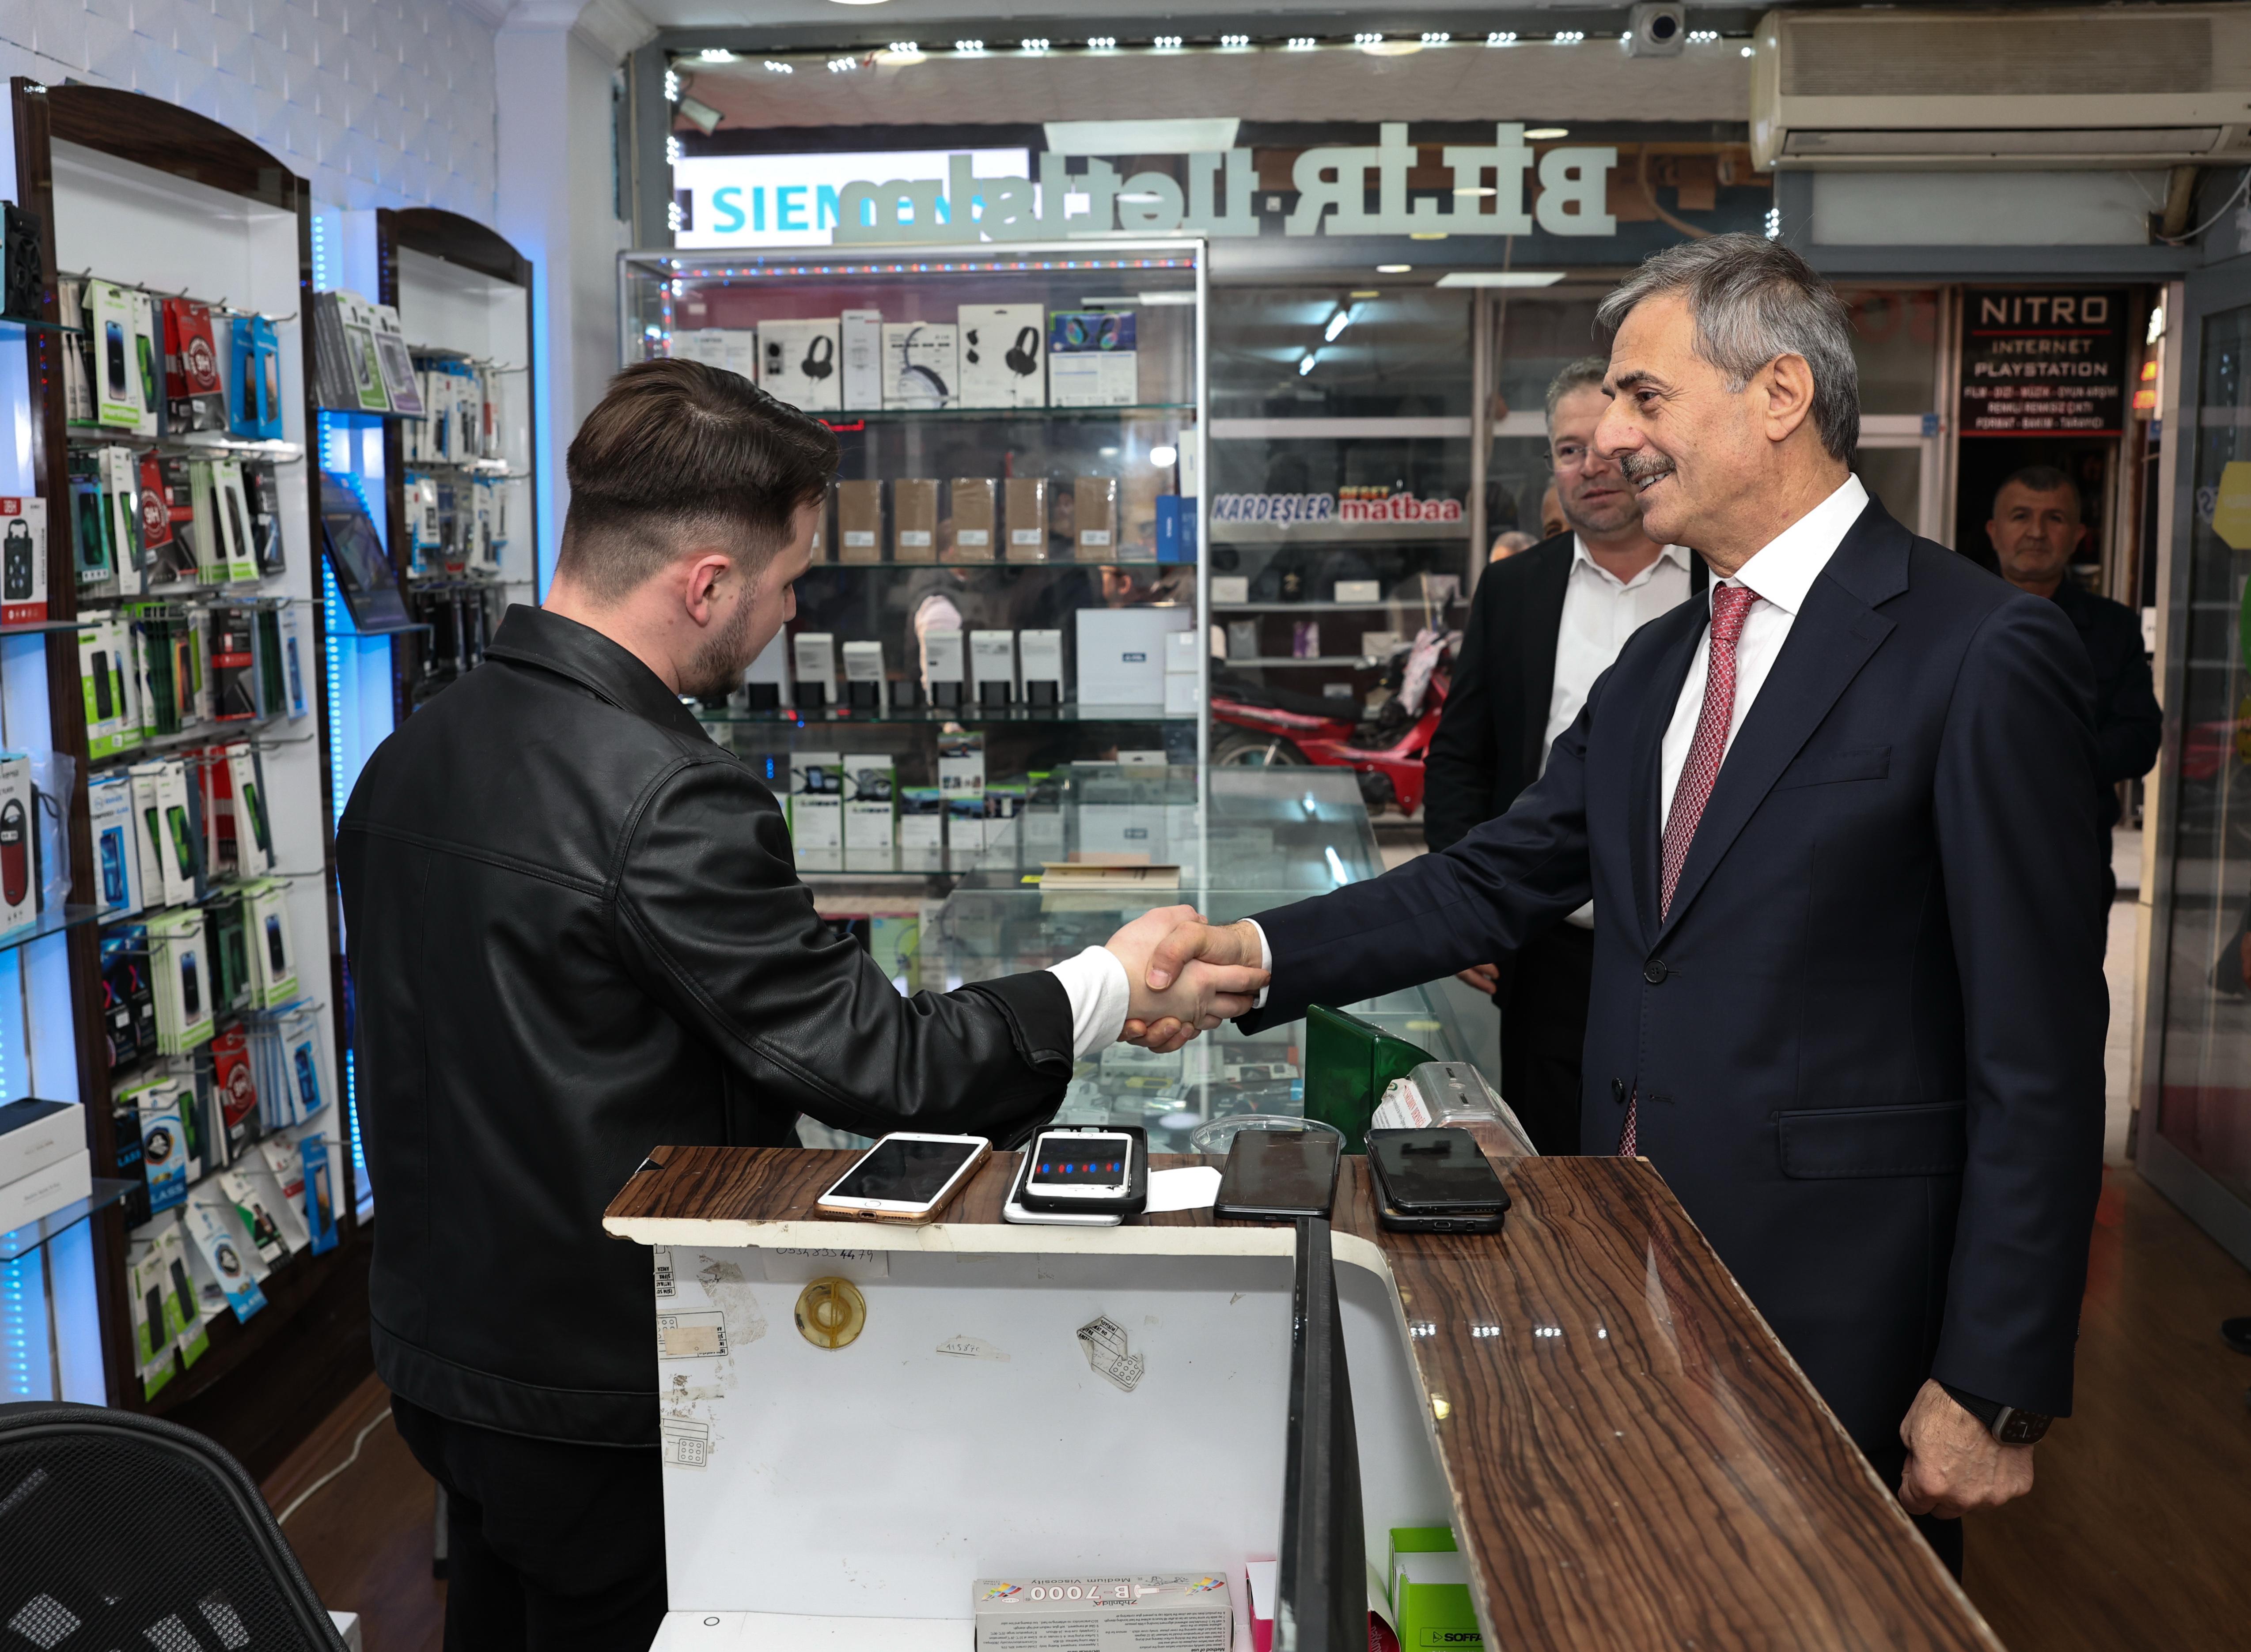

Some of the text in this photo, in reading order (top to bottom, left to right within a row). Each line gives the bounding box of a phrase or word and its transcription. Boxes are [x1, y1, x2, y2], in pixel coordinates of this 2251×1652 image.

[1981, 296, 2108, 325] NITRO
[1992, 339, 2093, 354] INTERNET
[1974, 362, 2108, 377] PLAYSTATION
[1213, 494, 1459, 525] KARDEŞLER matbaa
[1031, 1585, 1130, 1601] B-7000
